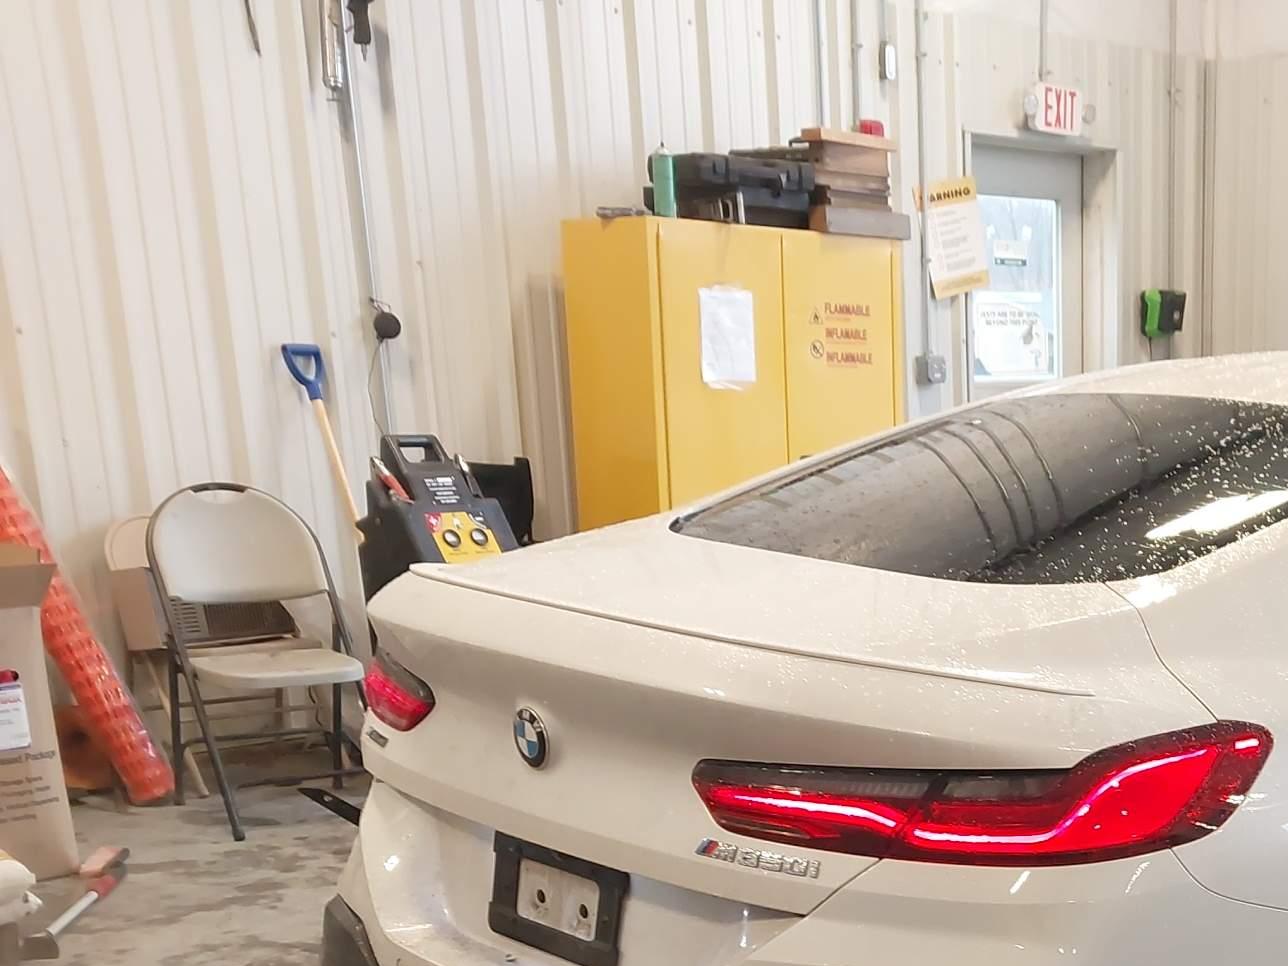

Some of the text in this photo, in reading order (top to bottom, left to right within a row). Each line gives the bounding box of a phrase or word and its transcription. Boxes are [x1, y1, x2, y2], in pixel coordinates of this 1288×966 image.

[1045, 86, 1077, 131] EXIT
[919, 186, 971, 203] ARNING
[824, 301, 871, 317] FLAMMABLE
